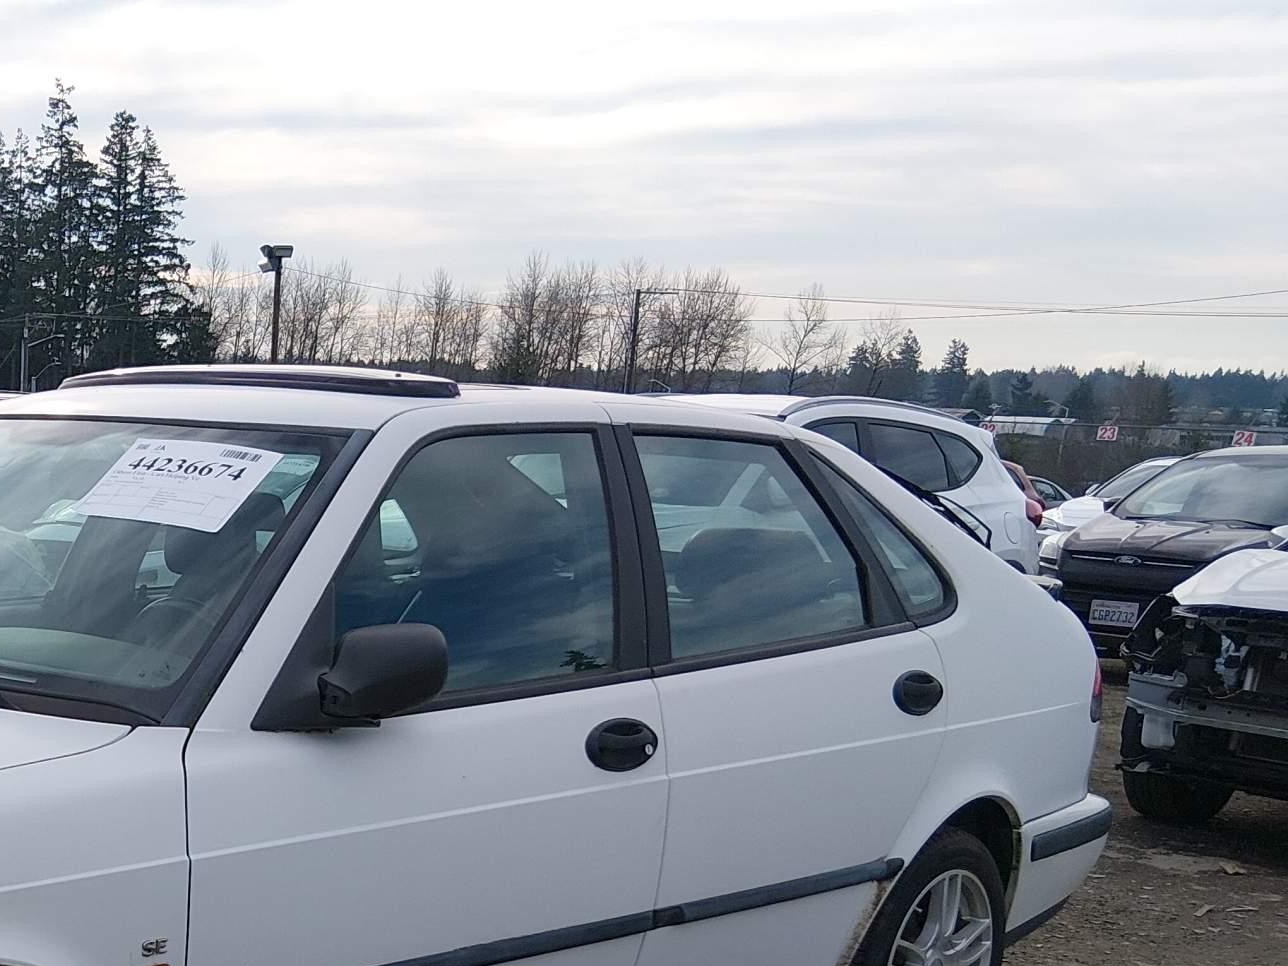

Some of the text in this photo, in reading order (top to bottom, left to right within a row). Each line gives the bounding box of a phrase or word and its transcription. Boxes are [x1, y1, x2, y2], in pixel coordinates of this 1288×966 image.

[1098, 427, 1116, 440] 23
[1233, 431, 1254, 446] 24
[128, 456, 247, 480] 44236674
[141, 938, 168, 957] SE
